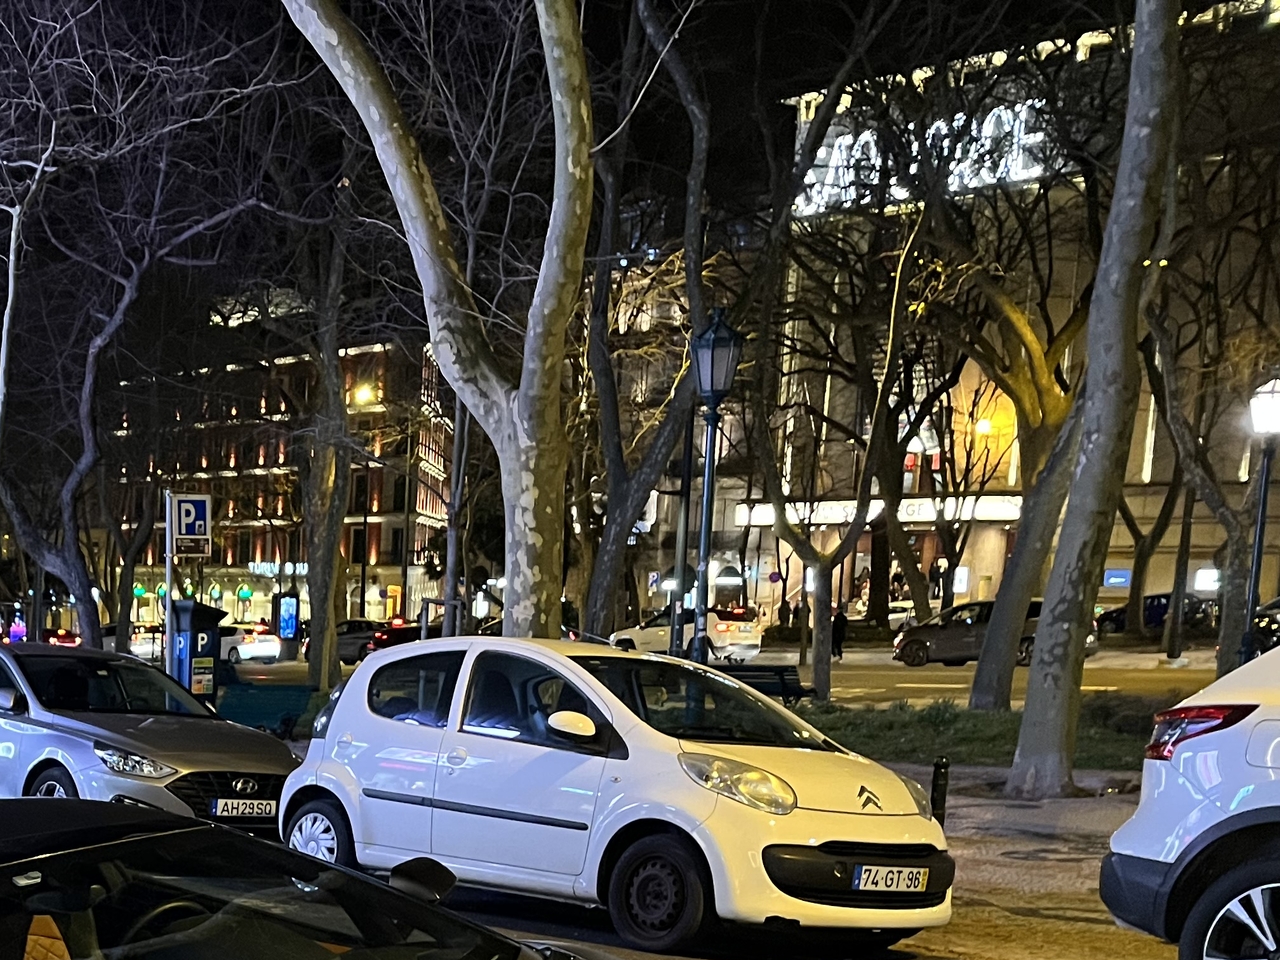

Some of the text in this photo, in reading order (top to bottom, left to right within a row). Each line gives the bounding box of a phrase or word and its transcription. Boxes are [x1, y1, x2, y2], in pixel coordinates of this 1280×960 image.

[181, 502, 196, 534] P
[176, 632, 208, 656] P P
